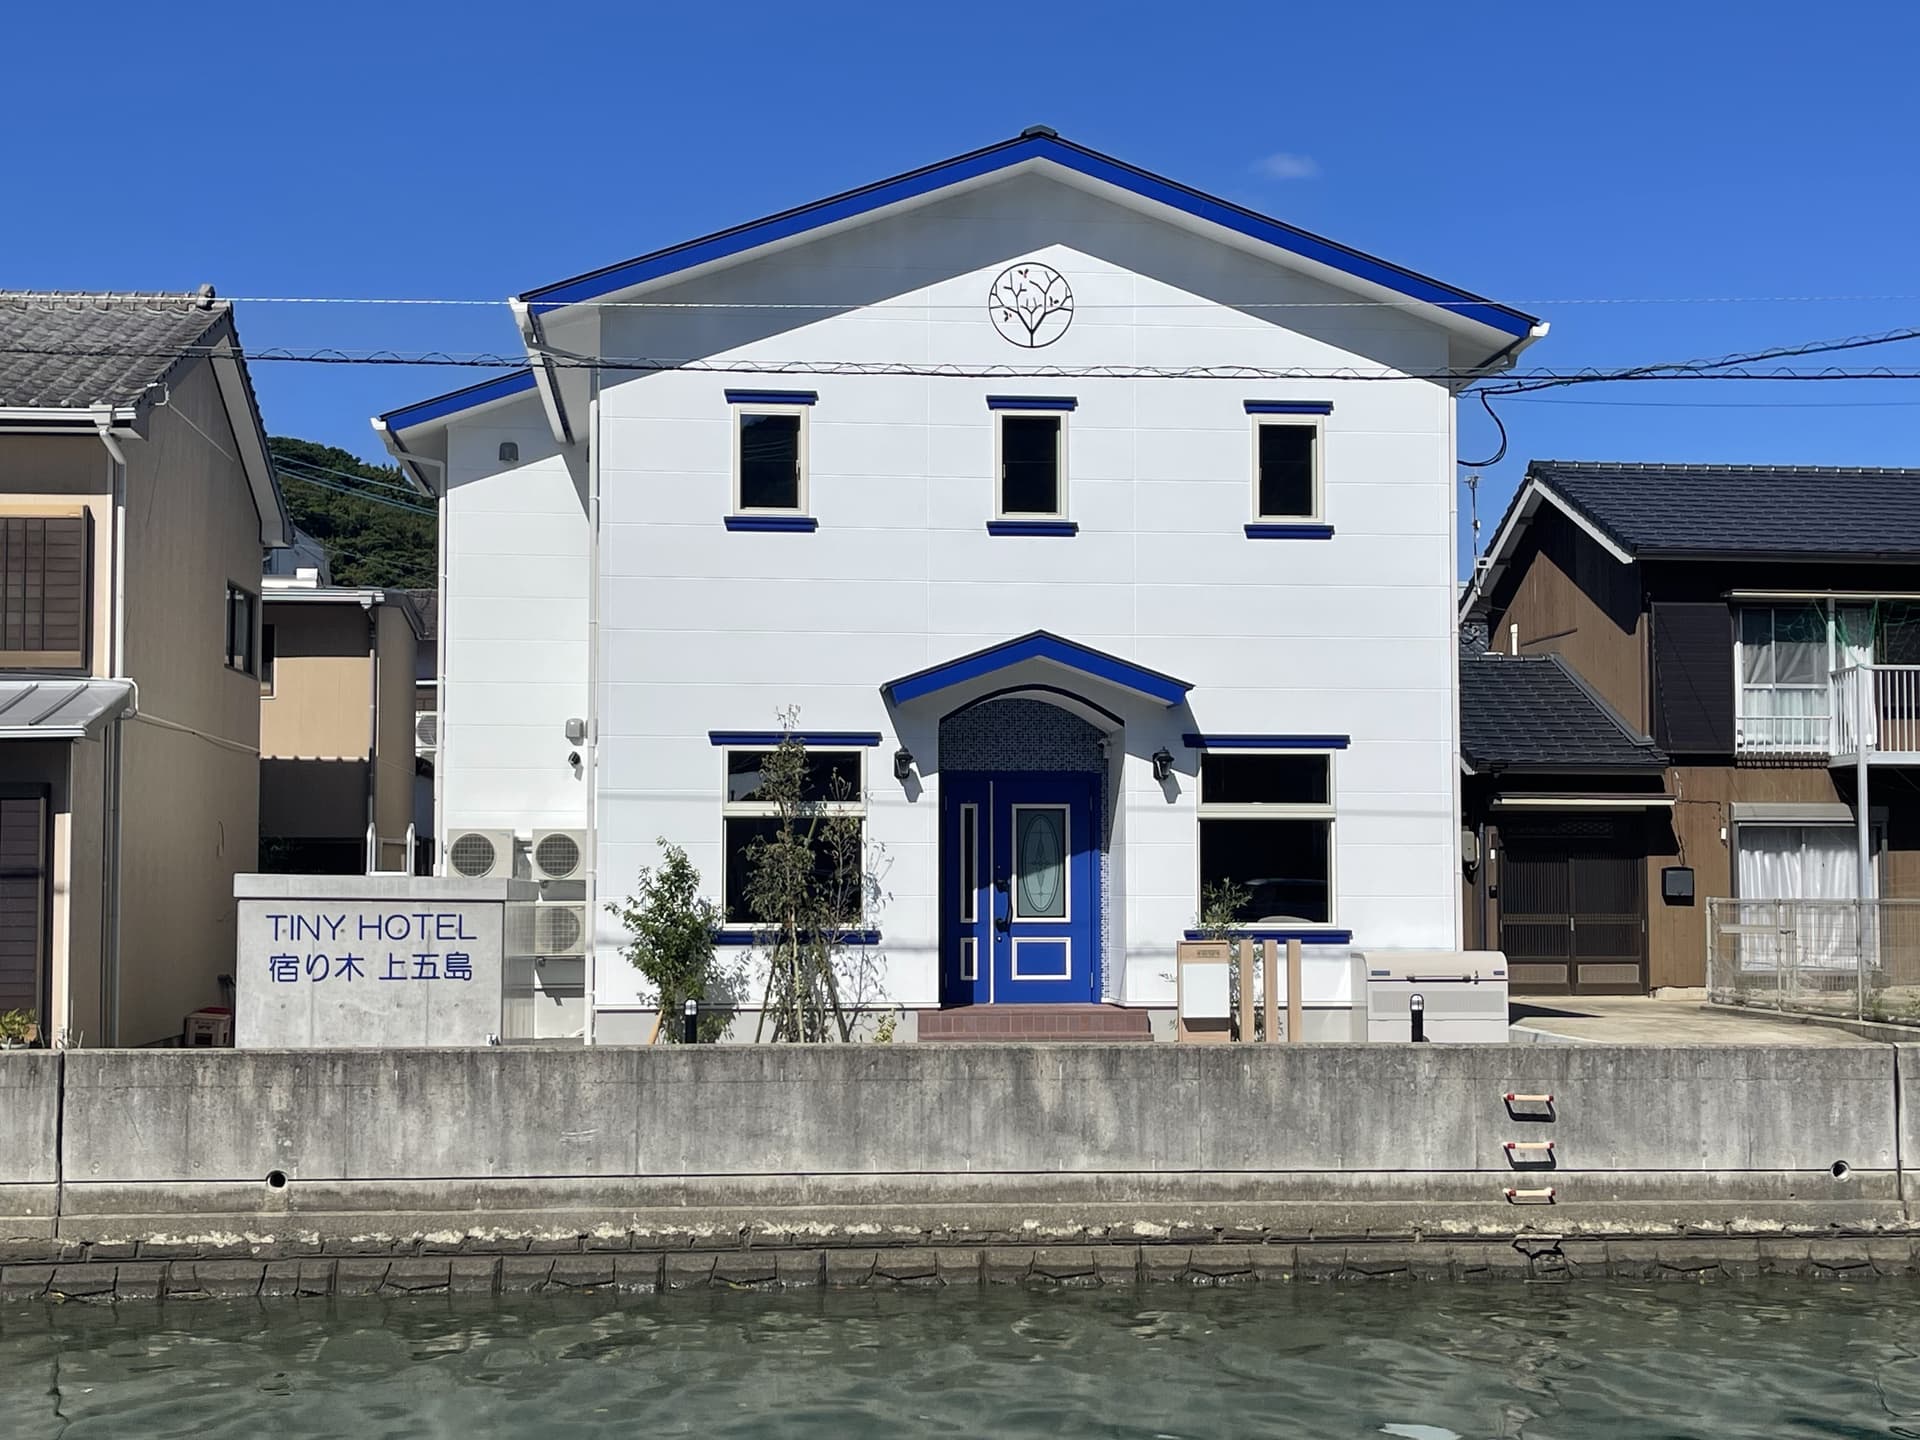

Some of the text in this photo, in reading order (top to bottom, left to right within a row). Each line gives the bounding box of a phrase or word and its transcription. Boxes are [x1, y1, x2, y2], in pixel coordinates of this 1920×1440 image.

[266, 914, 477, 941] TINY HOTEL
[269, 952, 472, 982] 宿り木 上五島
